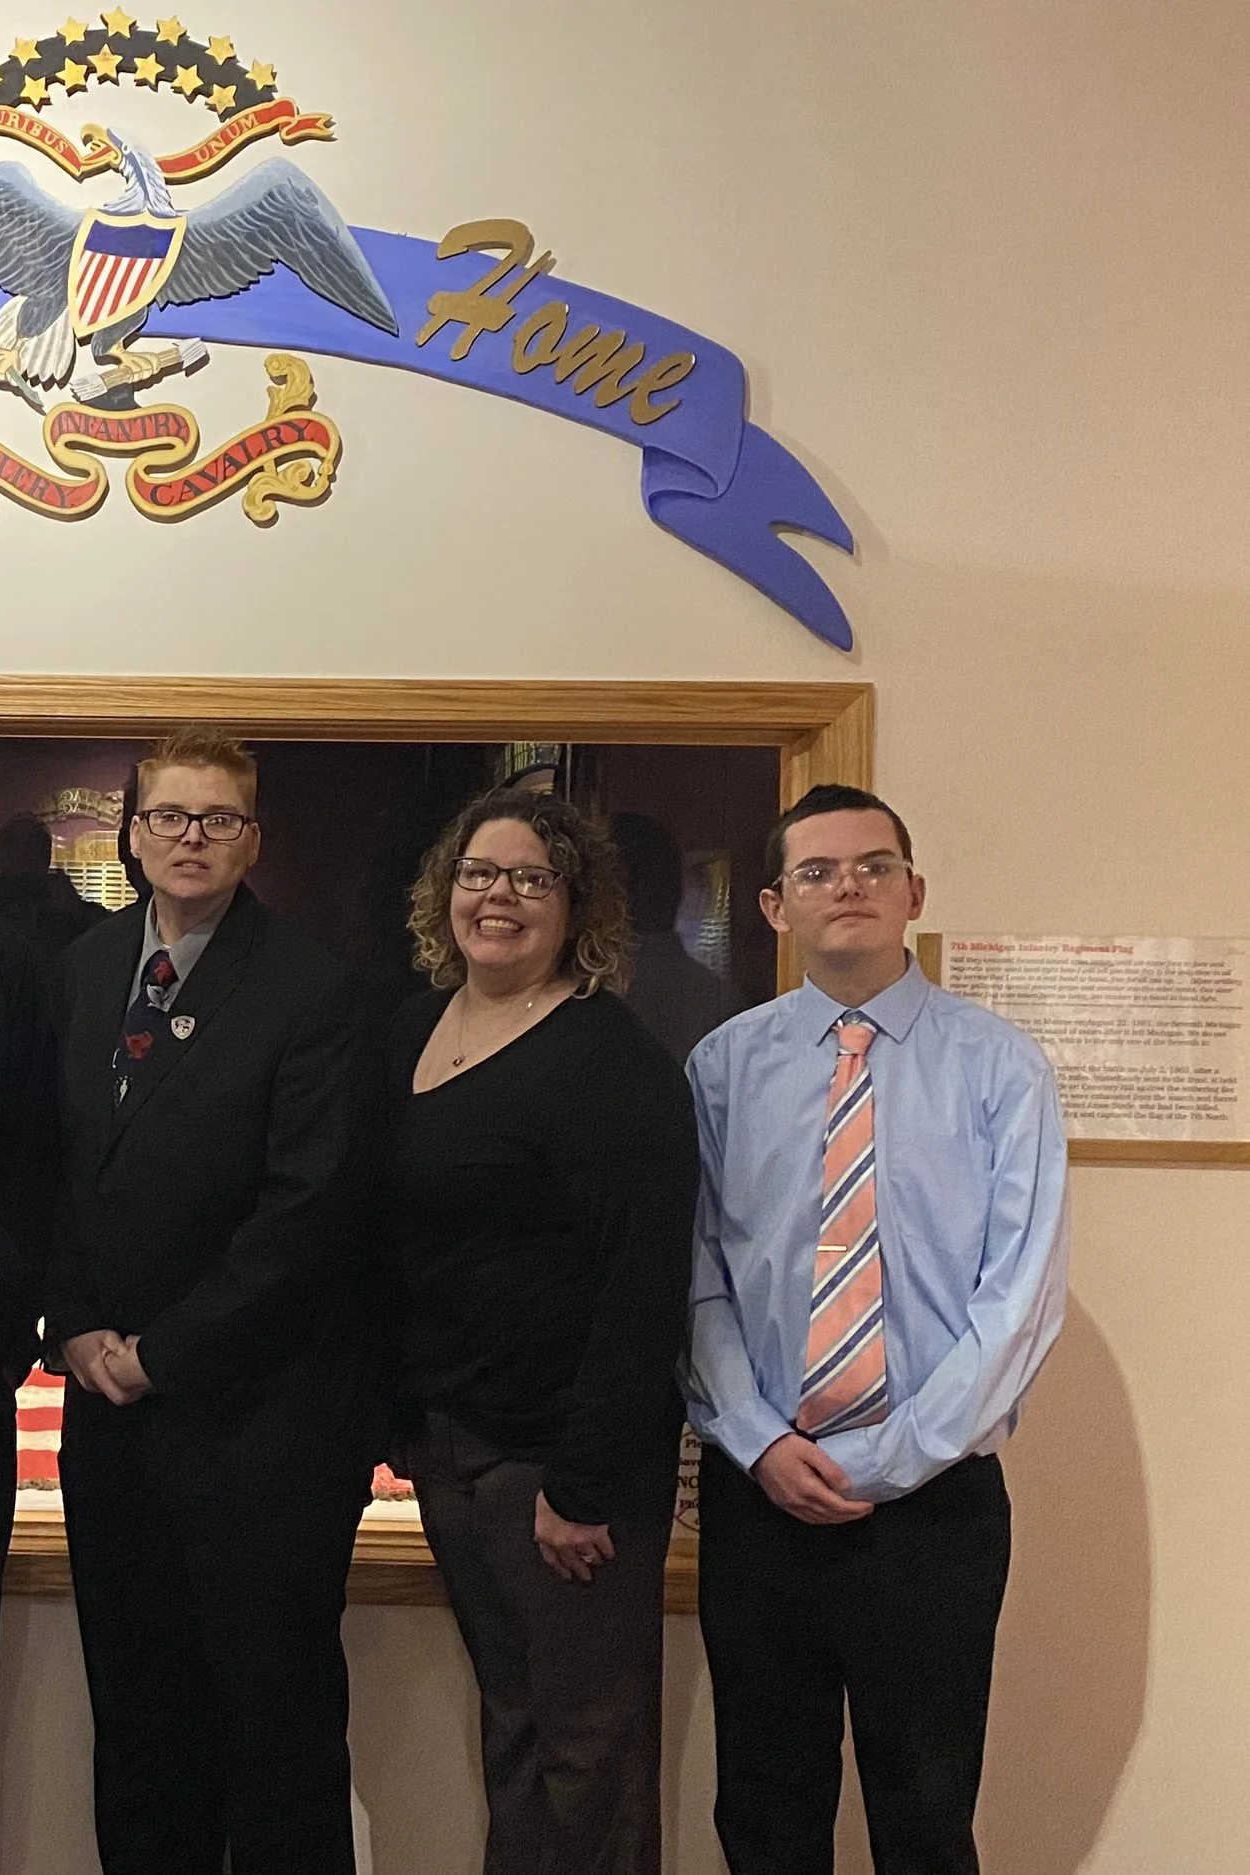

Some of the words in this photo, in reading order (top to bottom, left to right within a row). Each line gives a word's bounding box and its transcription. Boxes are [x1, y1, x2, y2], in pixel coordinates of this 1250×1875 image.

[194, 112, 260, 162] UNUM
[415, 218, 697, 426] Home
[56, 411, 188, 442] INFANTRY
[150, 419, 312, 506] CAVALRY
